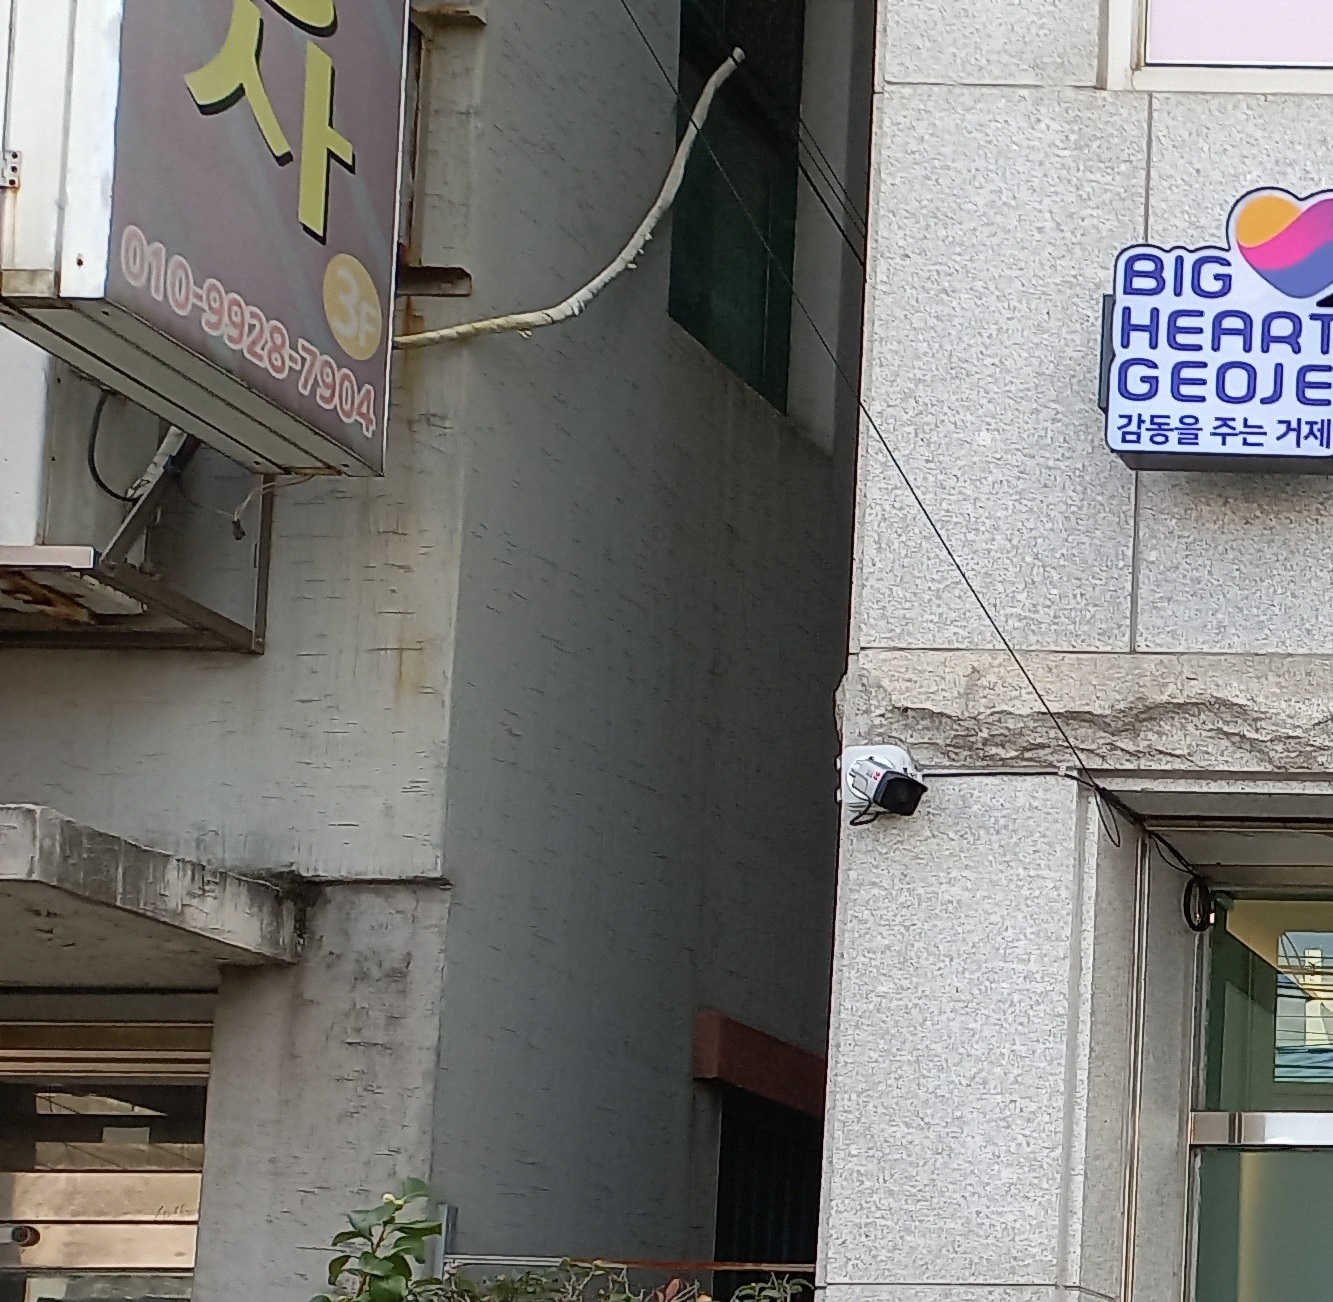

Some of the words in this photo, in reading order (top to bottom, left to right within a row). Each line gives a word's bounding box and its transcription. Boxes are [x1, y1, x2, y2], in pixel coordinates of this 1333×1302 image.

[1122, 253, 1233, 299] BIG
[121, 225, 376, 438] 010-9928-7904
[333, 267, 378, 347] 3F
[1117, 357, 1333, 407] GEOJE
[1117, 413, 1204, 447] 감동을
[1209, 416, 1268, 448] 주는
[1275, 417, 1333, 450] 거제
